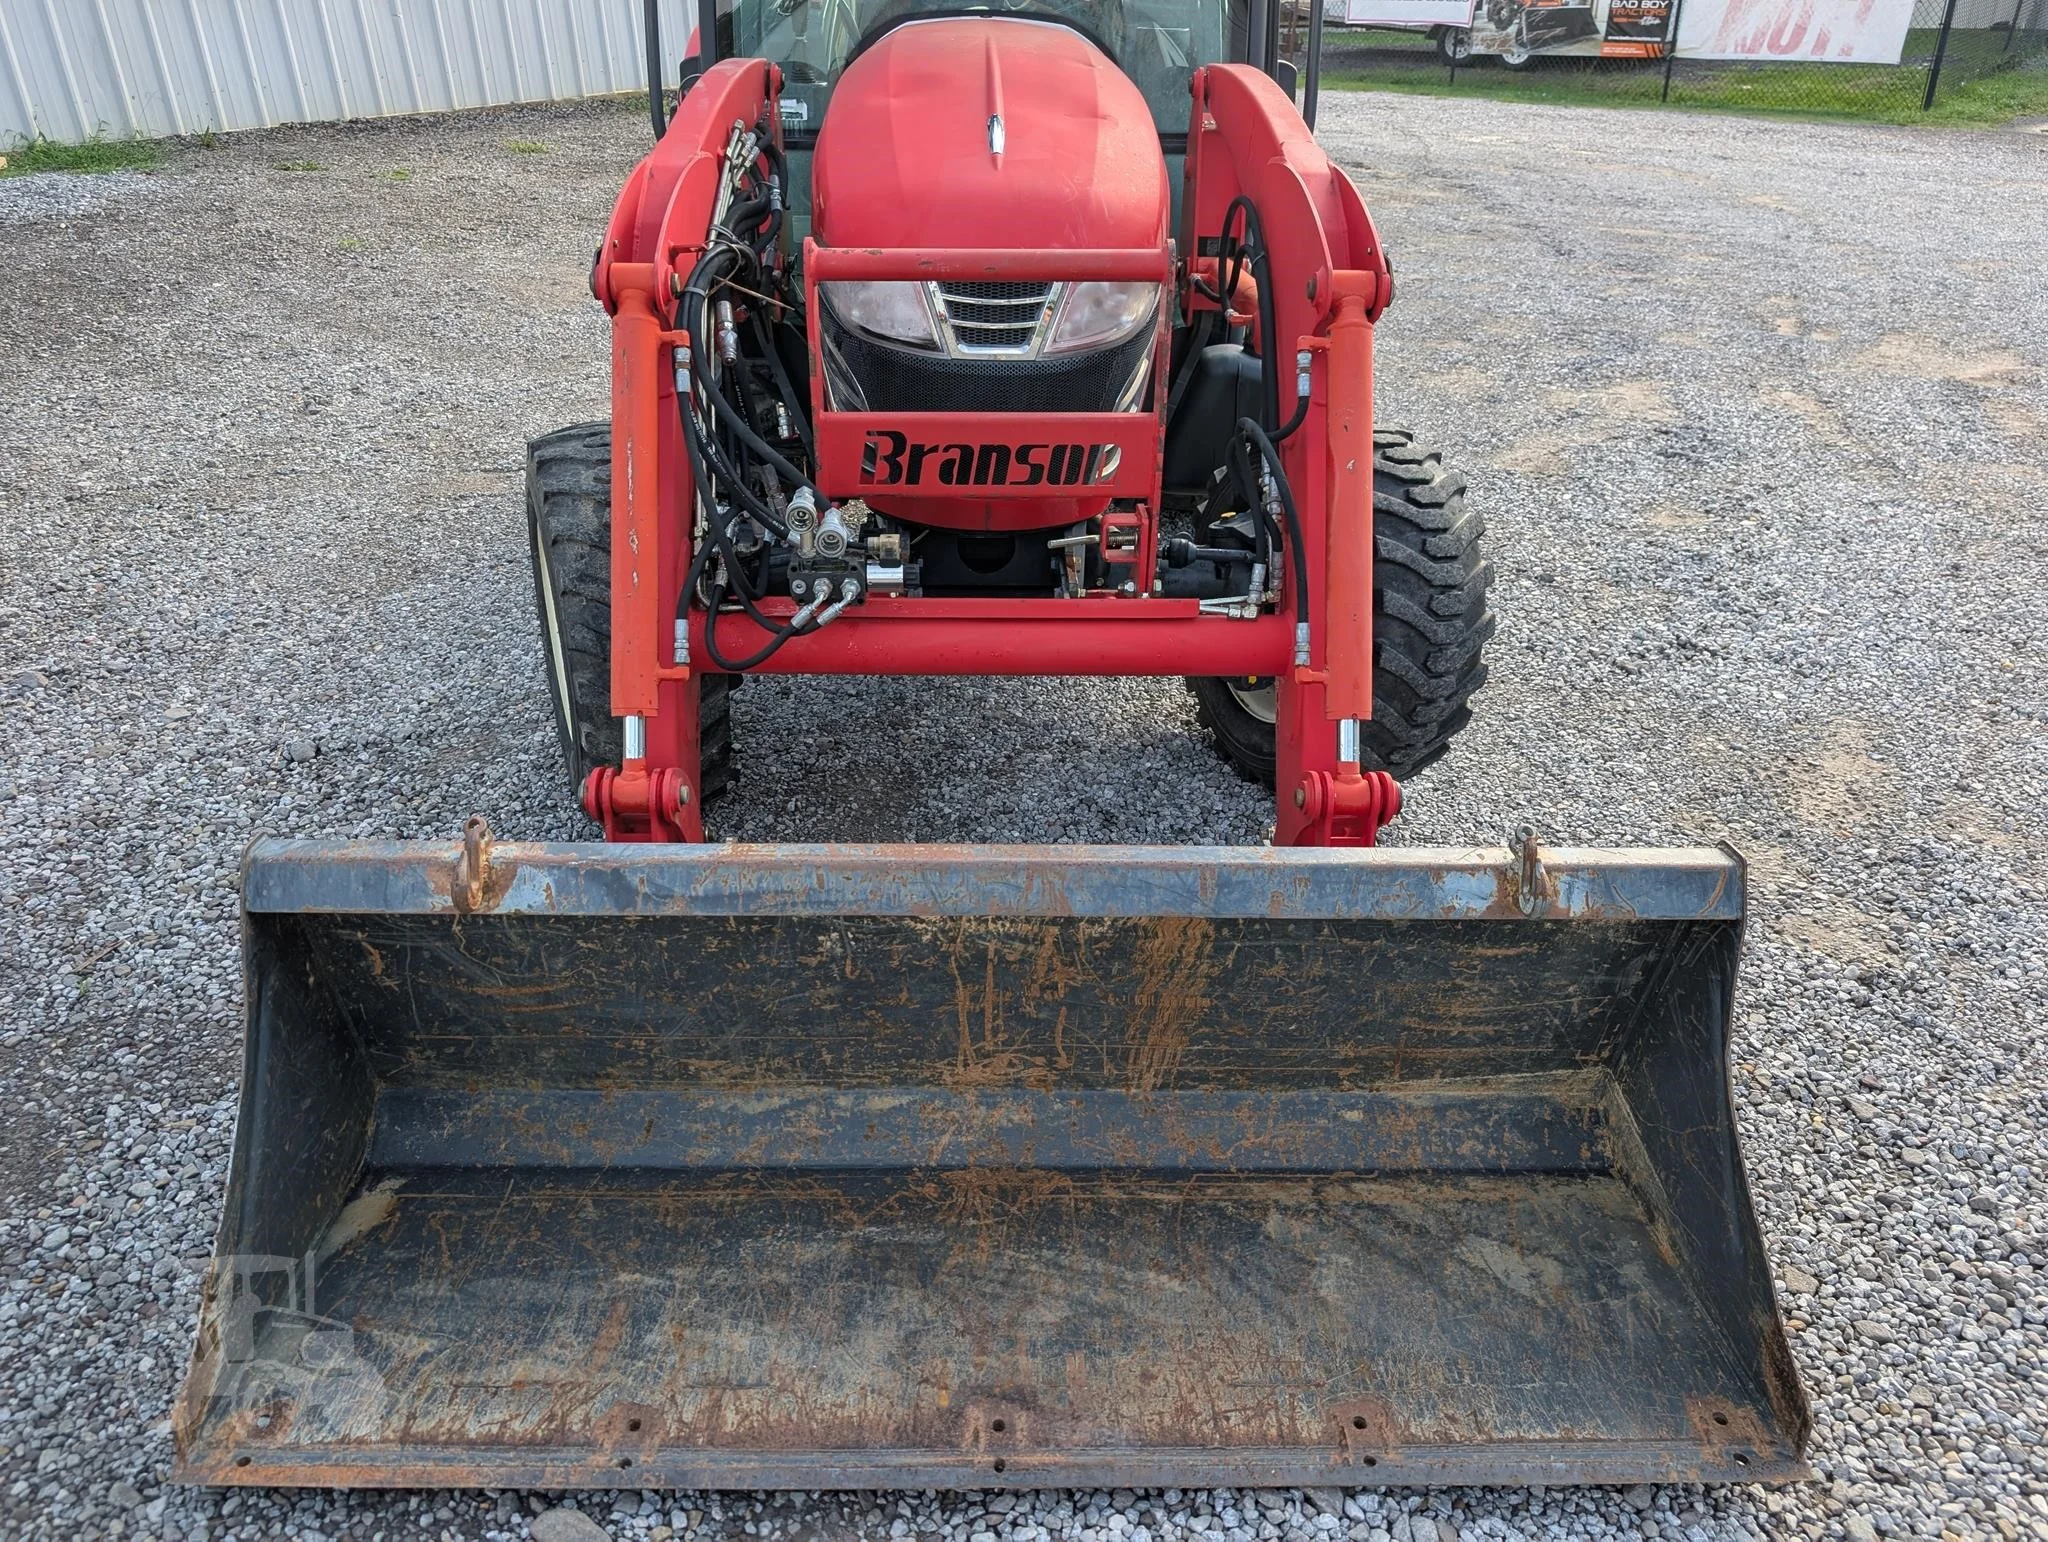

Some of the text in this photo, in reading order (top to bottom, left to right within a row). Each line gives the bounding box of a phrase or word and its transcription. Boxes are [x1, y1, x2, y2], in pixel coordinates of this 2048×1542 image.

[1611, 0, 1669, 9] BAD BOY
[1612, 8, 1668, 16] TRACTORS
[858, 430, 1122, 486] Branson
